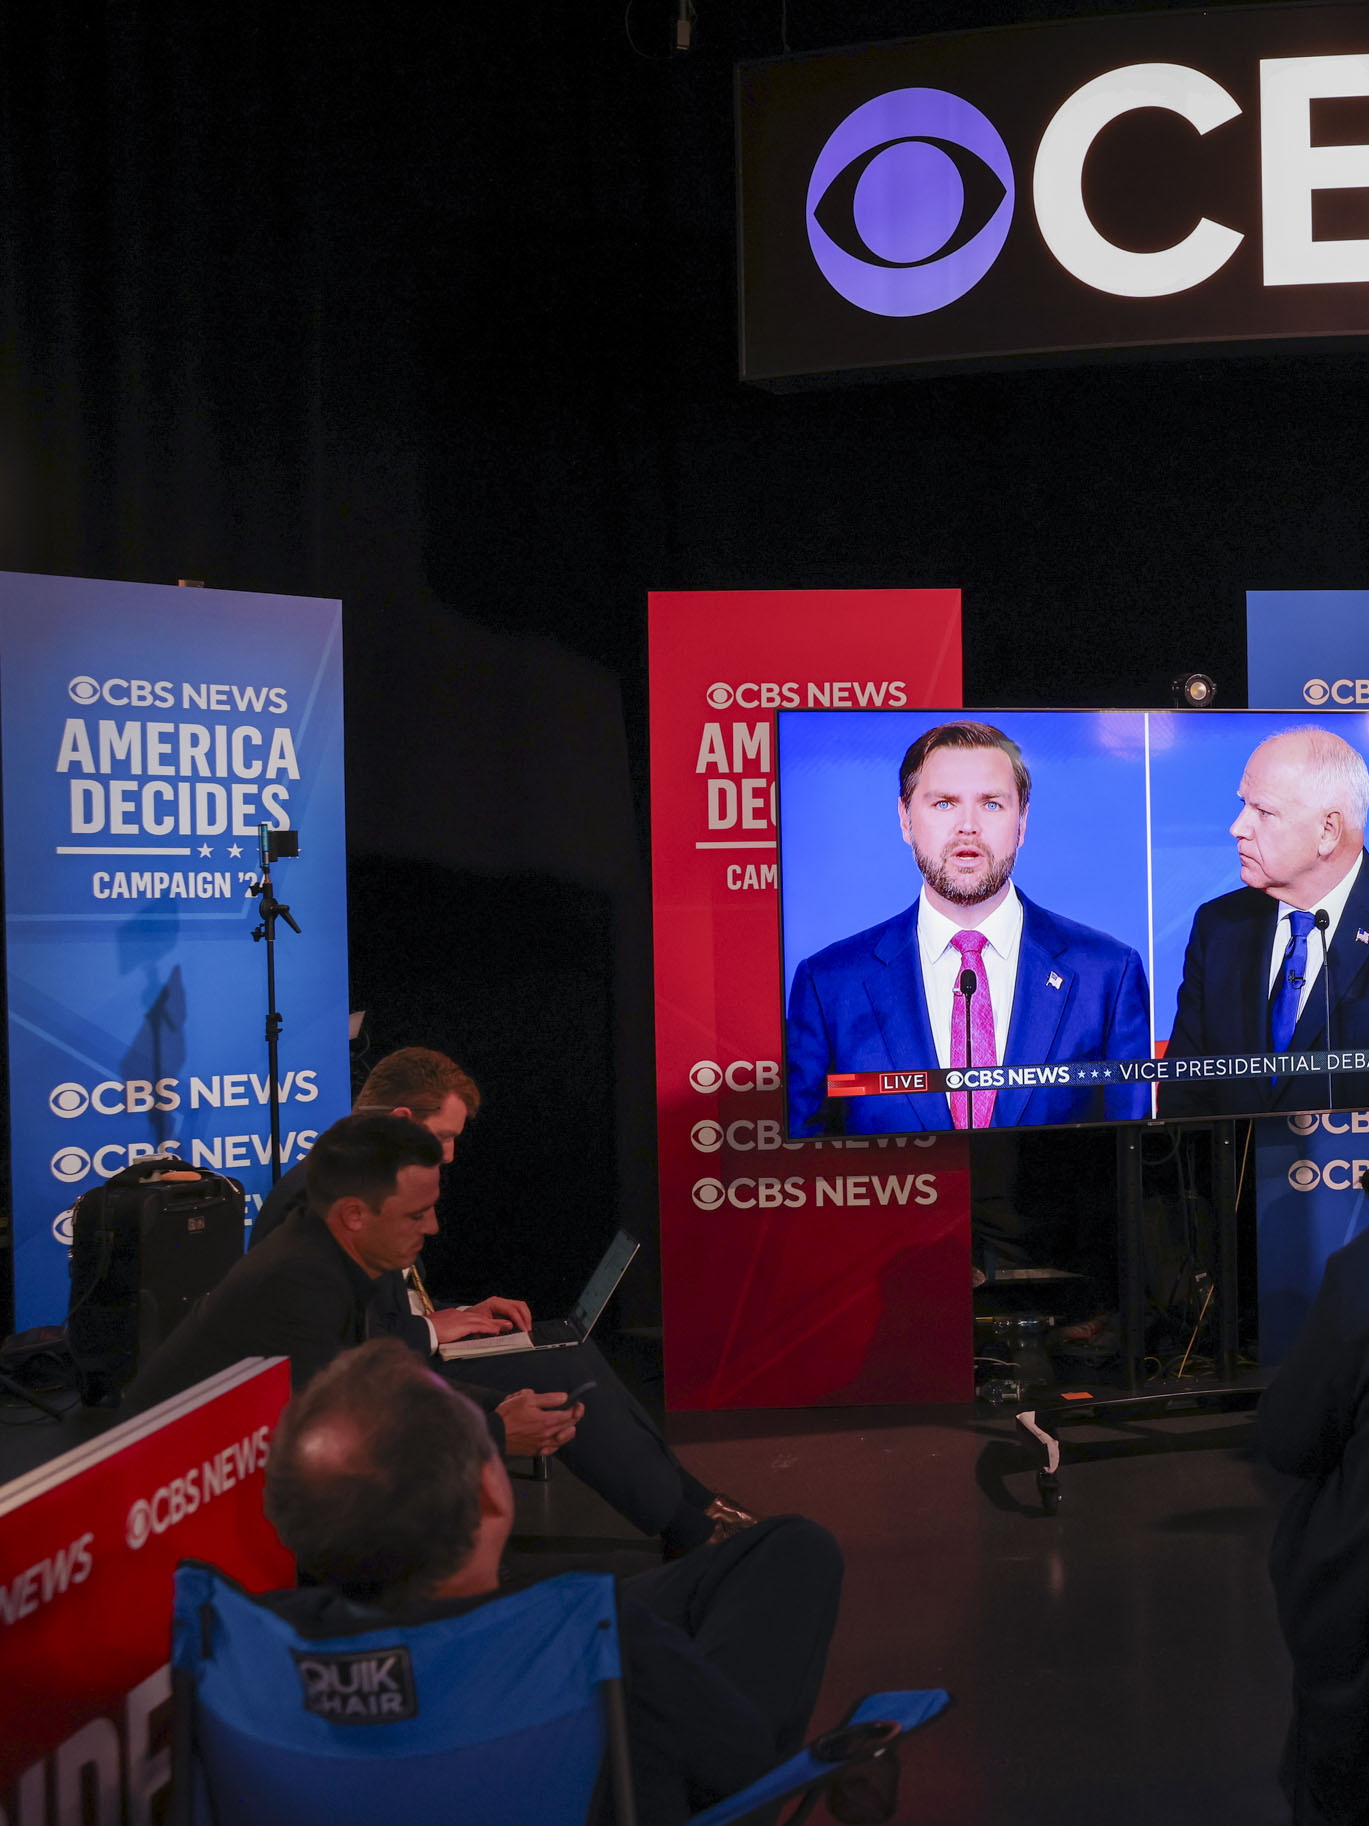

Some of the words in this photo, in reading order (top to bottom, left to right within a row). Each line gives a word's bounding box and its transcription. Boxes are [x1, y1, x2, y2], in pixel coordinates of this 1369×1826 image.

[102, 678, 175, 709] CBS
[182, 683, 288, 714] NEWS
[735, 682, 801, 708] CBS
[807, 681, 908, 707] NEWS
[56, 718, 301, 780] AMERICA
[70, 779, 292, 836] DECIDES
[93, 871, 231, 898] CAMPAIGN
[724, 1060, 783, 1092] CB
[883, 1074, 925, 1090] LIVE
[964, 1069, 1004, 1087] CBS
[1008, 1066, 1070, 1086] NEWS
[1119, 1062, 1169, 1080] VICE
[1175, 1055, 1321, 1078] PRESIDENTIAL
[91, 1077, 181, 1115] CBS
[190, 1070, 319, 1110] NEWS
[726, 1119, 804, 1151] CB
[727, 1176, 806, 1209] CBS
[815, 1173, 938, 1207] NEWS
[151, 1468, 200, 1534] CBS
[202, 1425, 270, 1504] NEWS
[0, 1532, 94, 1625] NEWS
[301, 1656, 400, 1694] QUIK
